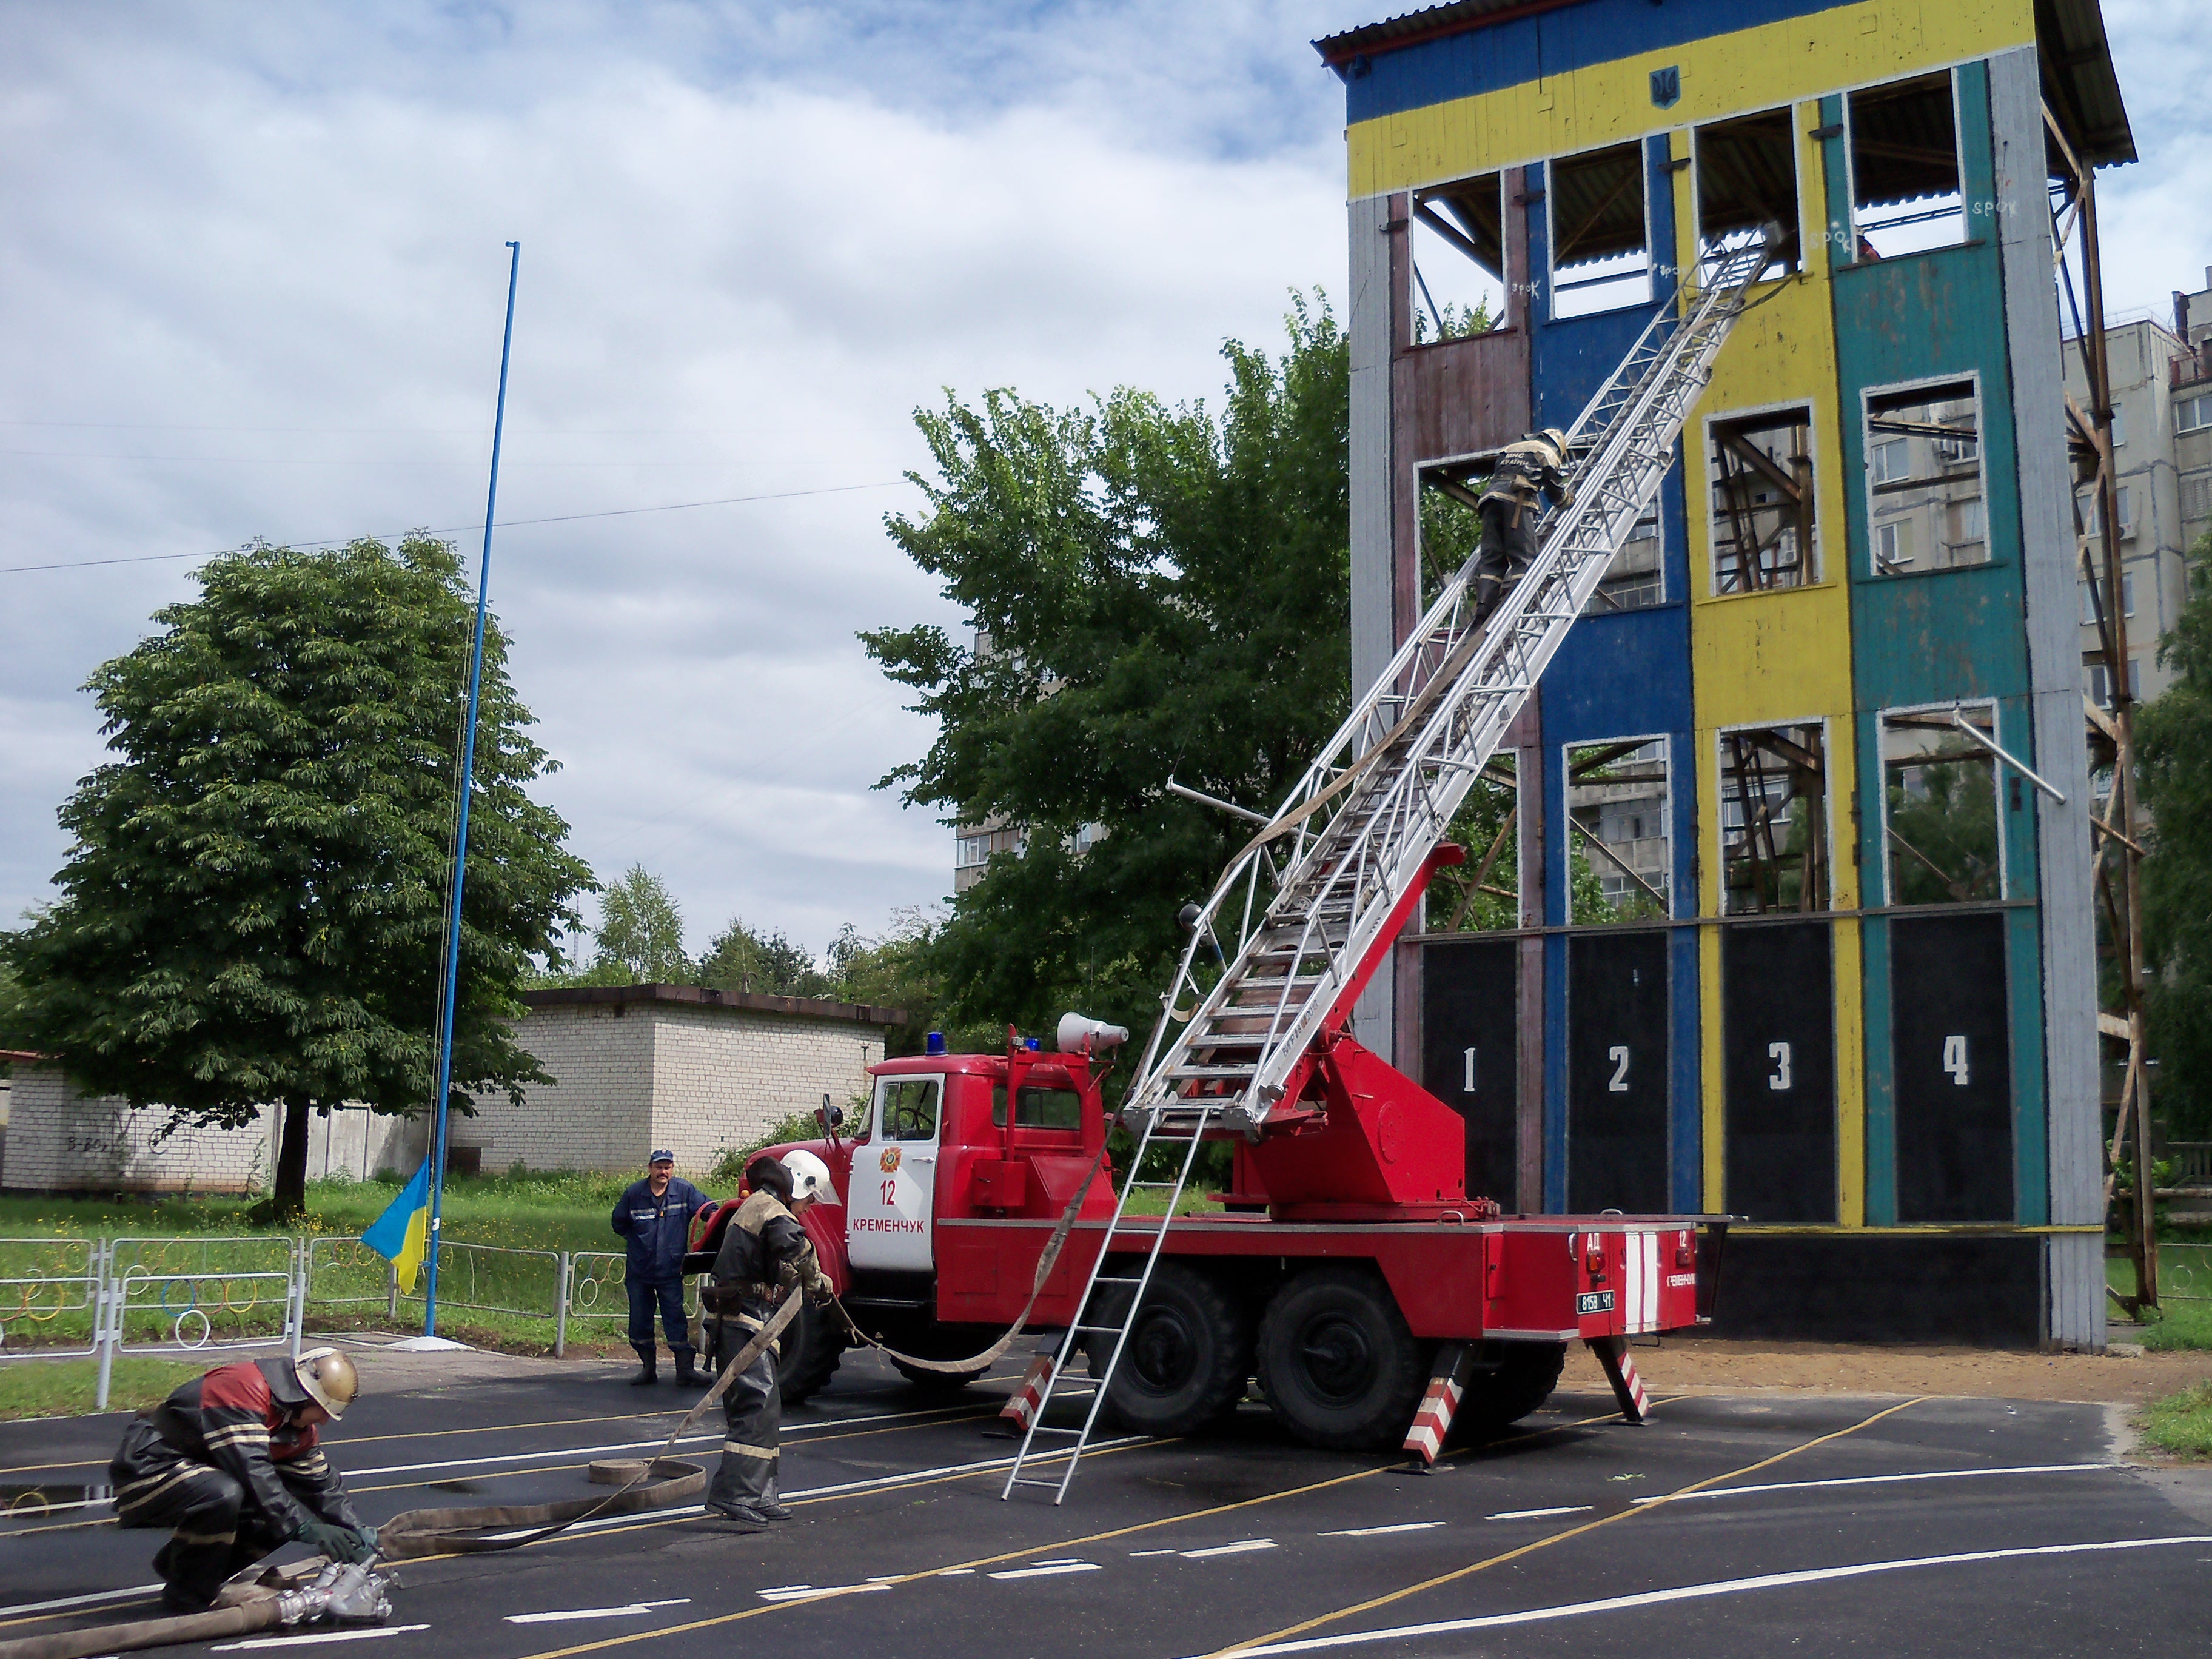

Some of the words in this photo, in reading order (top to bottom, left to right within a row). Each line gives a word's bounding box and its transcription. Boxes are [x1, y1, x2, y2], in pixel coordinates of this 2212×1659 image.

[1464, 1047, 1475, 1091] 1
[1609, 1046, 1629, 1091] 2
[1769, 1042, 1791, 1090] 3
[1943, 1036, 1968, 1085] 4
[880, 1179, 896, 1205] 12
[853, 1218, 925, 1233] КРЕМЕНЧУК
[1587, 1232, 1600, 1252] АД
[1678, 1230, 1687, 1247] 12
